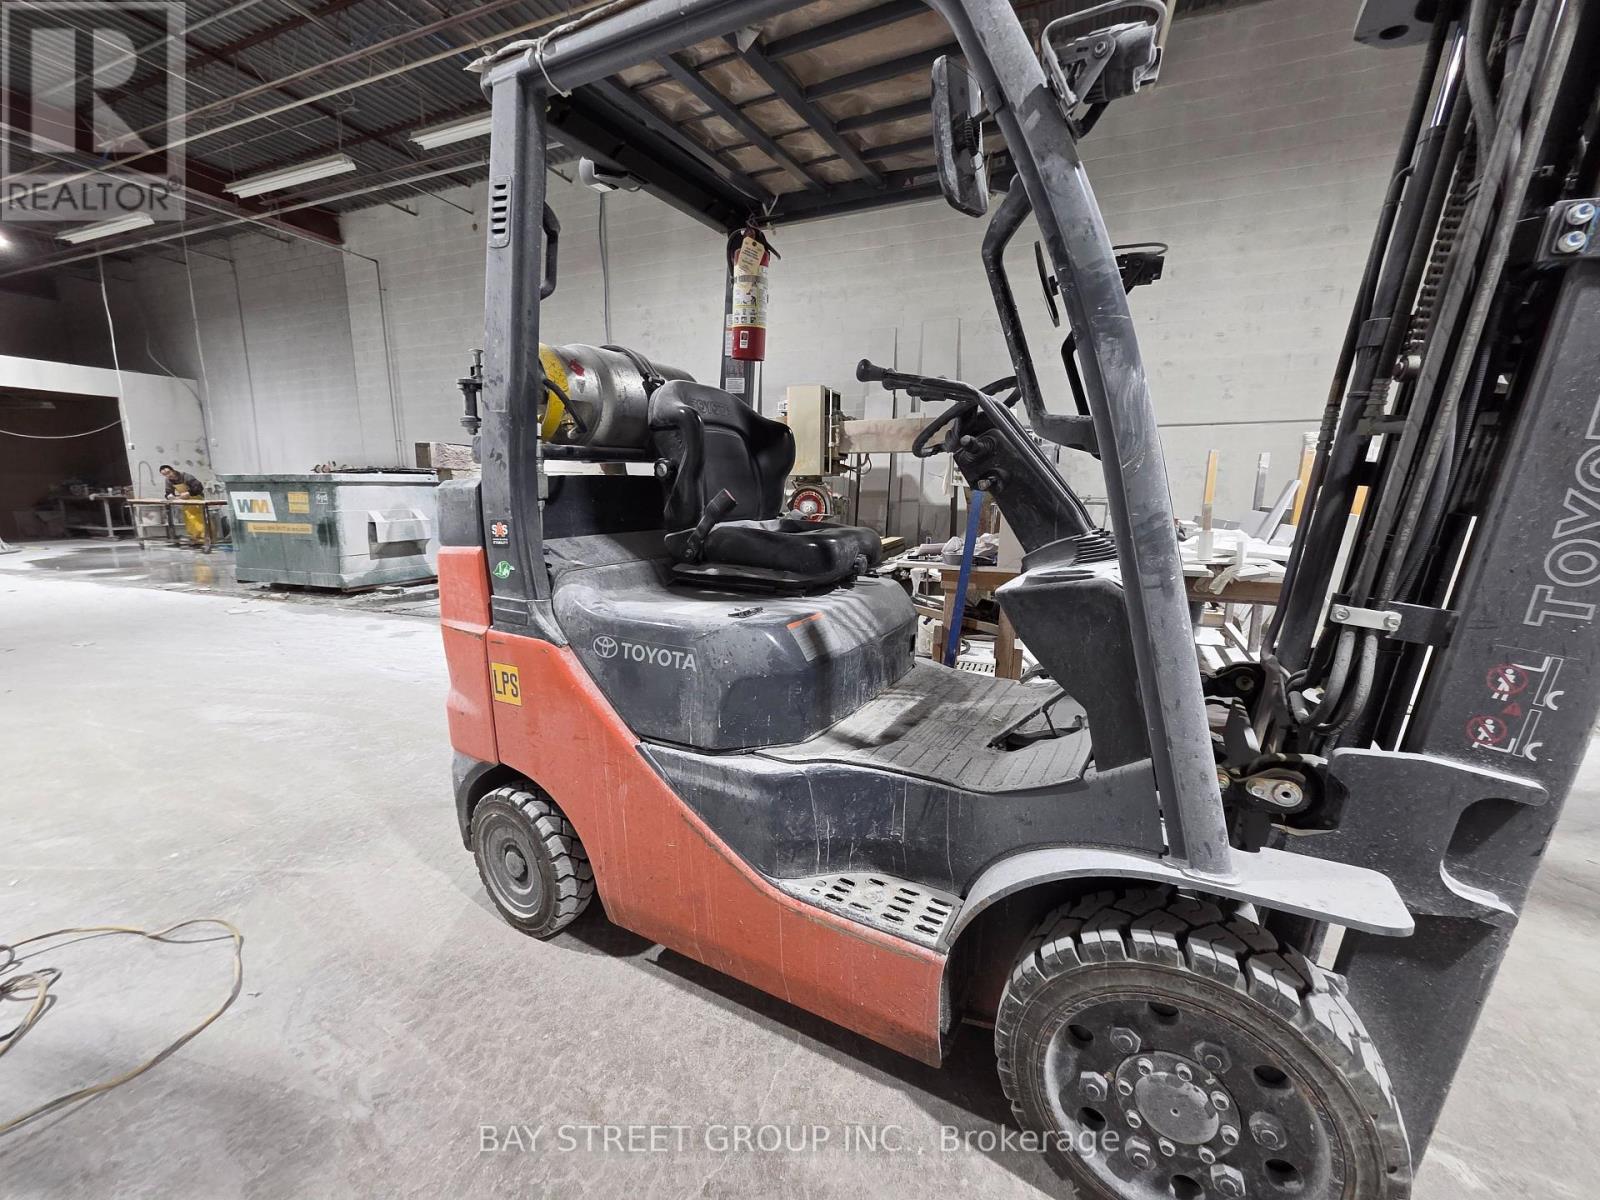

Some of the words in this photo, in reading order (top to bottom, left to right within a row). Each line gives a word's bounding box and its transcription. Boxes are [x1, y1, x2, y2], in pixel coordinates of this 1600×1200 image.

[236, 498, 271, 514] WM
[621, 642, 697, 672] TOYOTA
[493, 669, 519, 698] LPS
